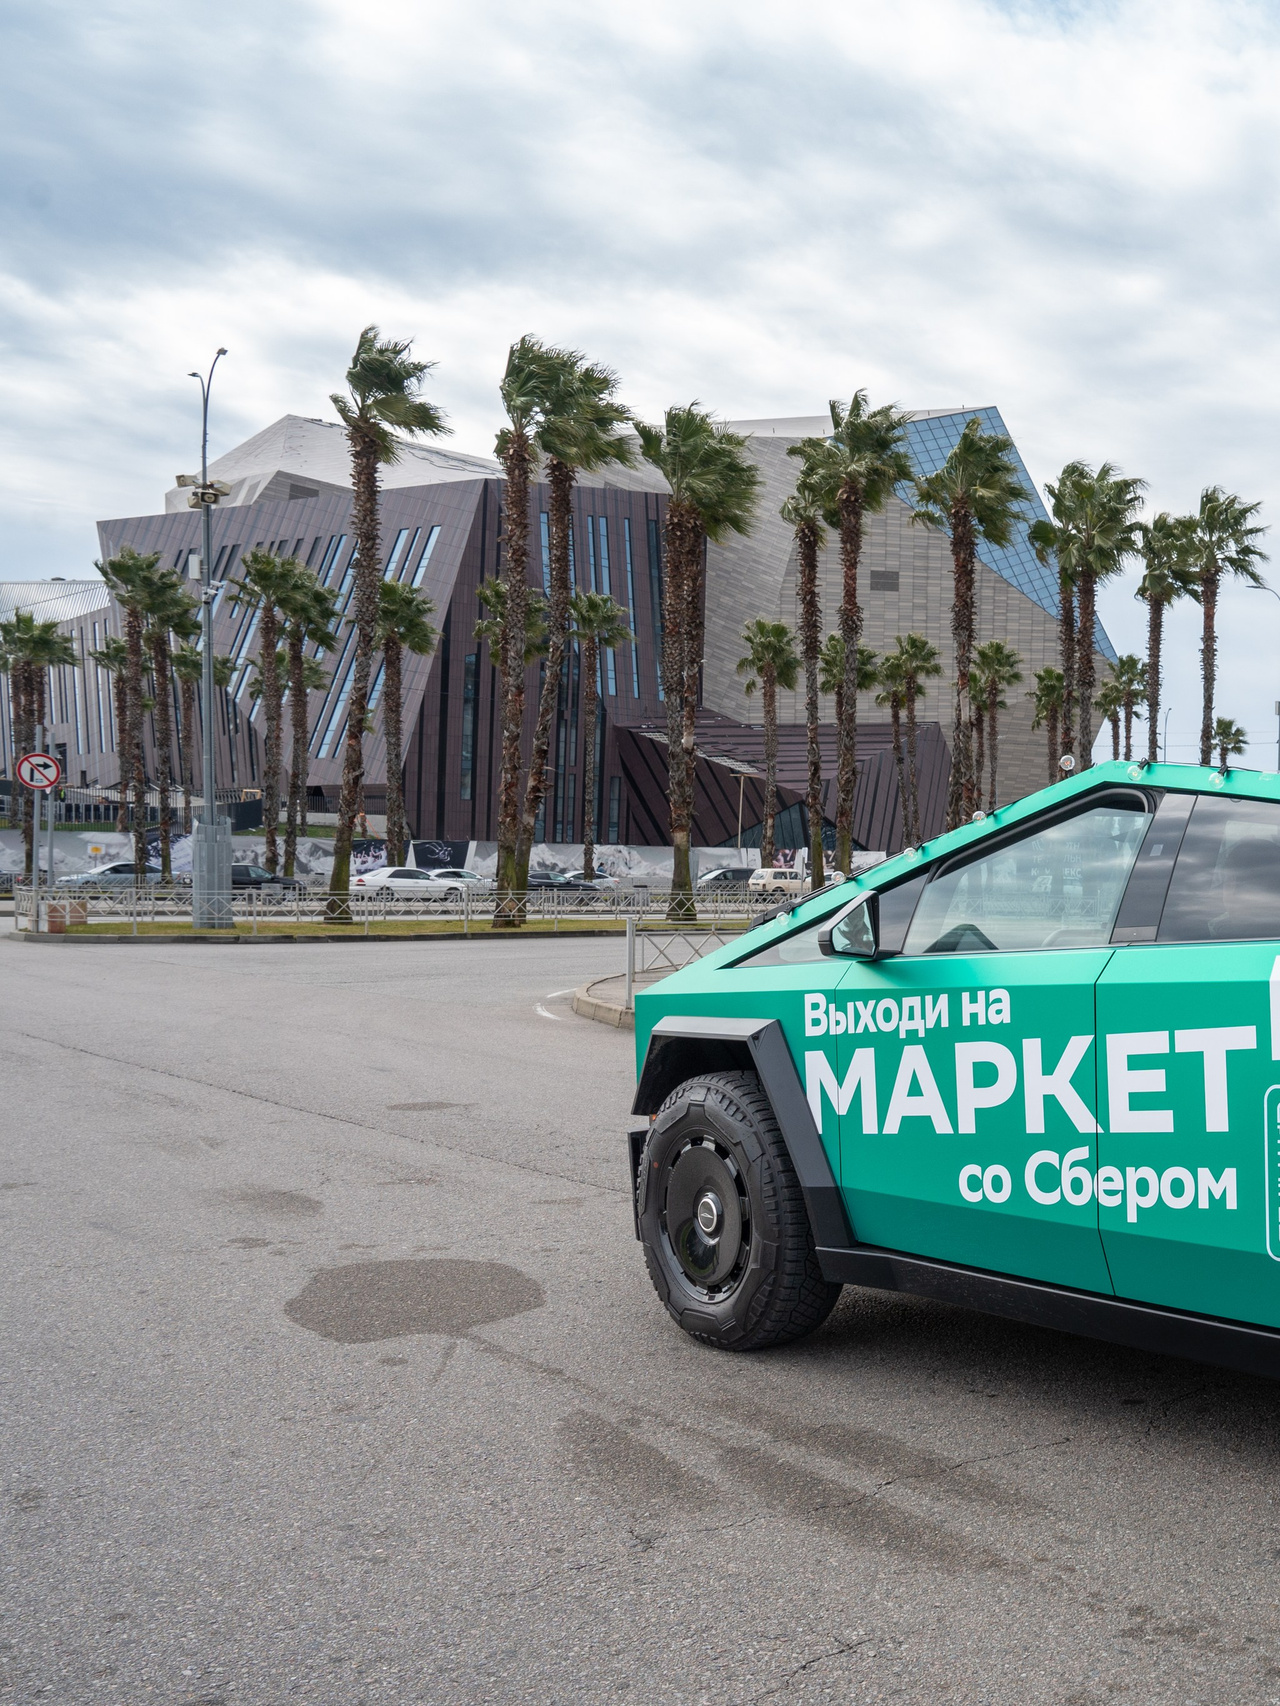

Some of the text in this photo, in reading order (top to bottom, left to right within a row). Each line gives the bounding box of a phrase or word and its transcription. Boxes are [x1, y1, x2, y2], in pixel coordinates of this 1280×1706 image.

[804, 988, 1011, 1038] Выходи на
[804, 1026, 1257, 1135] МАРКЕТ
[958, 1146, 1238, 1223] со Сбером
